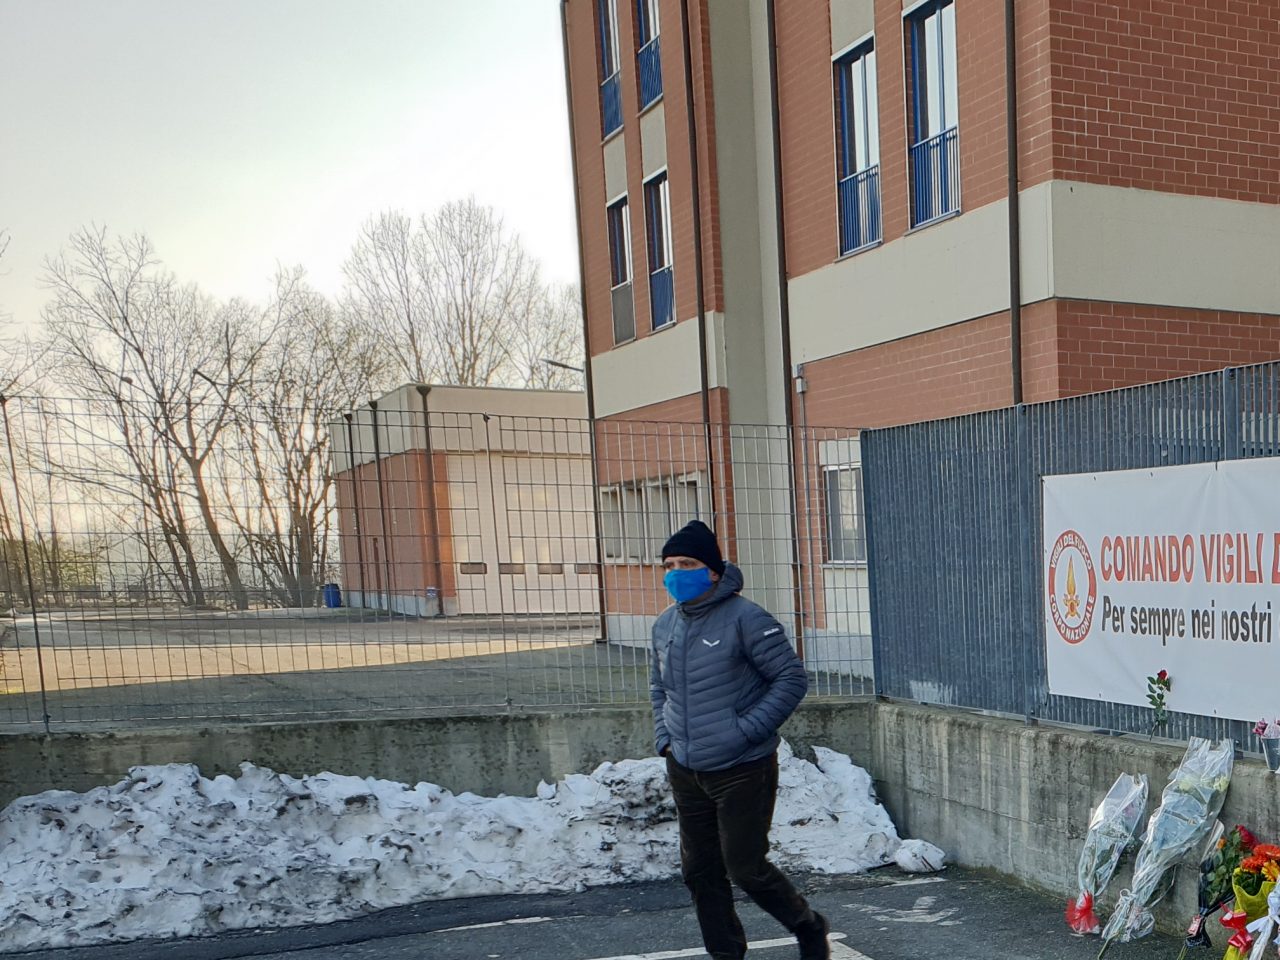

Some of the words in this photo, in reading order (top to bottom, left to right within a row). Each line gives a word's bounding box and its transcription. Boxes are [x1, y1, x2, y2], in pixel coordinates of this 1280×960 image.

[1050, 539, 1063, 569] VIGILI
[1063, 533, 1074, 546] DEL
[1075, 537, 1092, 570] FUOCO
[1101, 533, 1195, 582] COMANDO
[1200, 532, 1264, 584] VIGILI
[1050, 594, 1065, 634] CORPO
[1065, 594, 1095, 641] NAZIONALE
[1101, 595, 1125, 632] Per
[1130, 603, 1186, 646] sempre
[1191, 599, 1216, 640] nei
[1221, 600, 1272, 644] nostri
